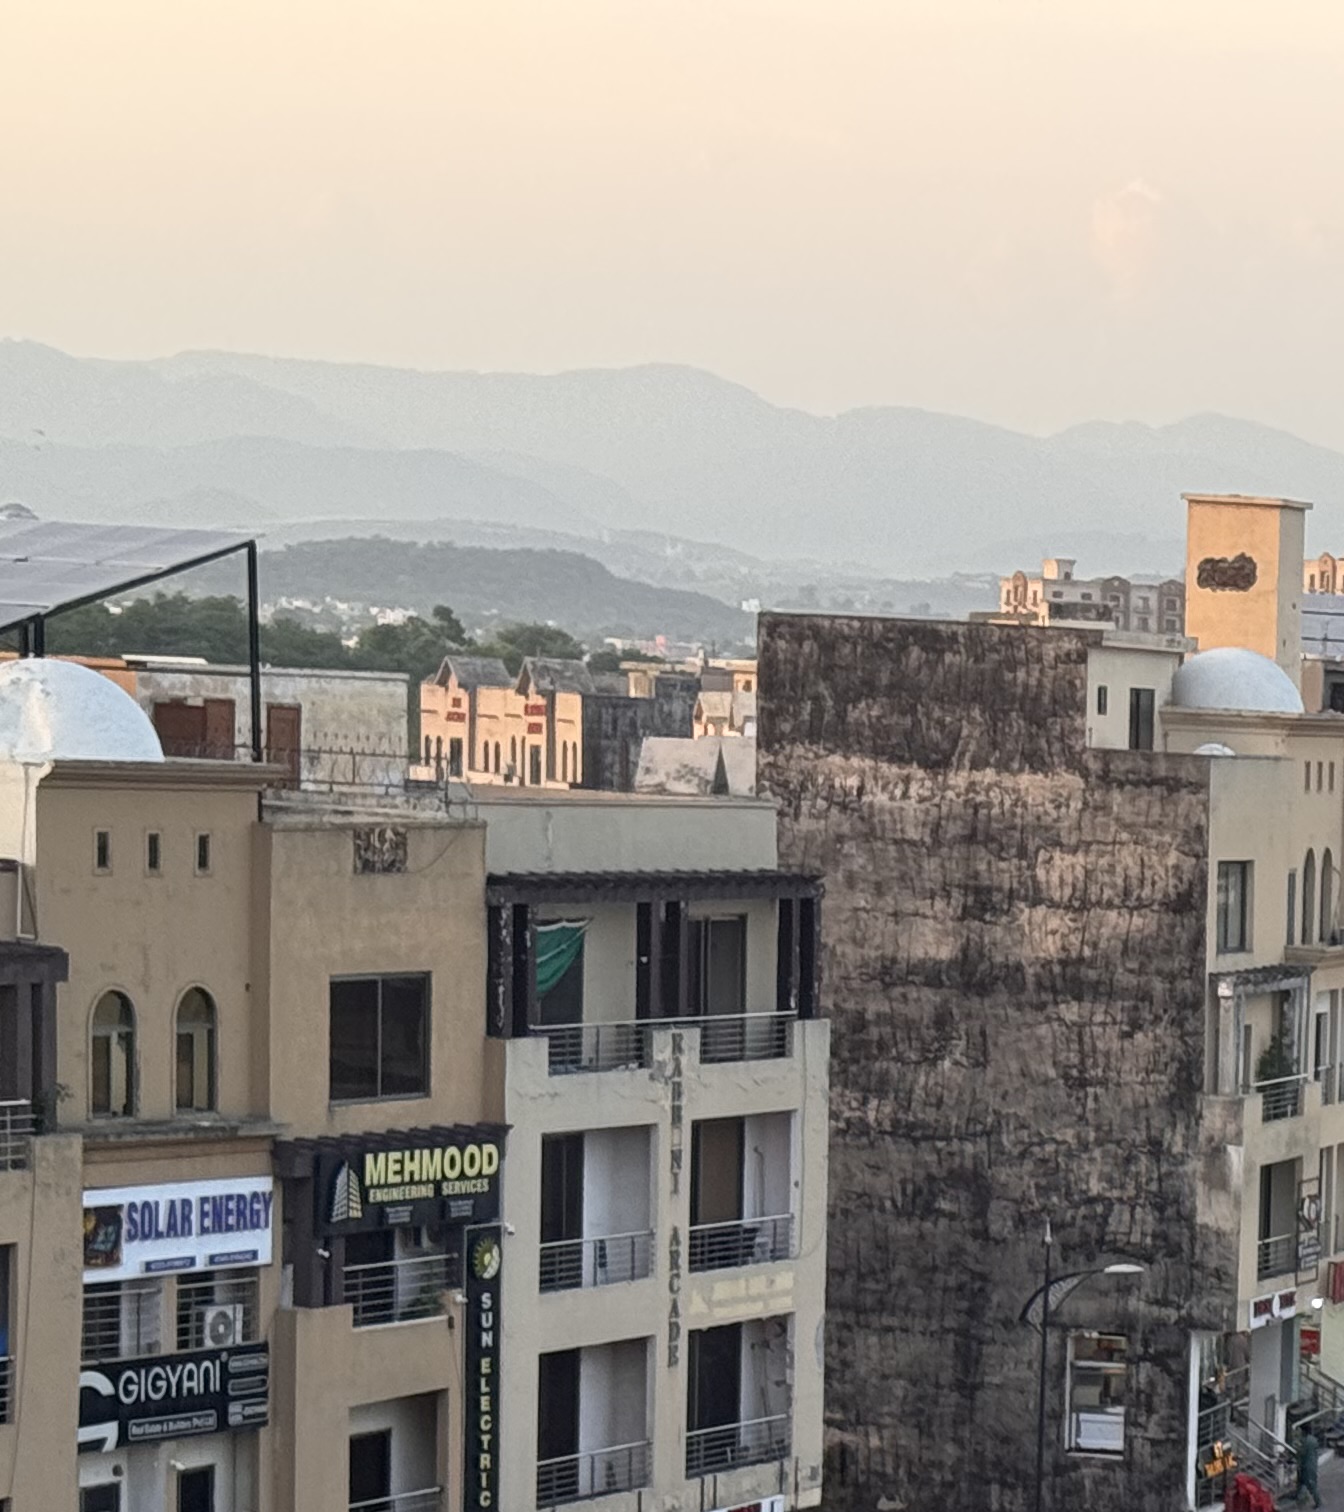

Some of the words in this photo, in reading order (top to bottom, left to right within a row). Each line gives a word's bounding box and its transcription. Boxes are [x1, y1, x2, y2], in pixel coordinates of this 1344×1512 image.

[364, 1143, 499, 1187] MEHMOOD
[368, 1183, 435, 1203] ENGINEERING
[441, 1178, 490, 1196] SERVICES
[126, 1198, 194, 1242] SOLAR
[197, 1190, 273, 1238] ENERGY
[480, 1292, 494, 1348] SUN
[479, 1357, 492, 1507] ELECTRIC
